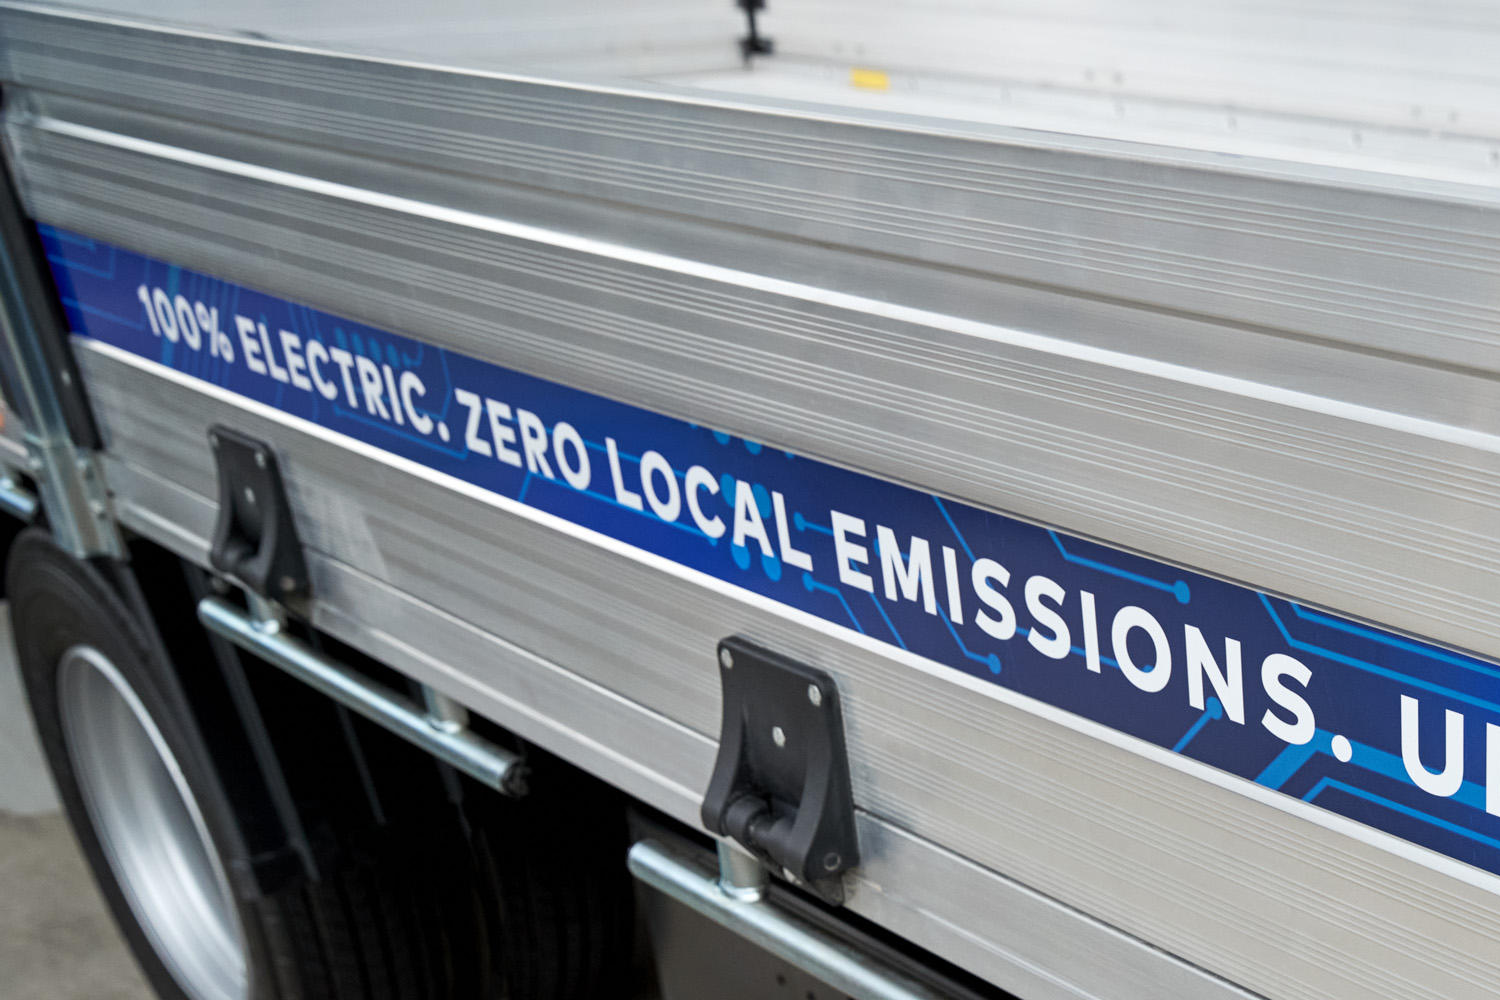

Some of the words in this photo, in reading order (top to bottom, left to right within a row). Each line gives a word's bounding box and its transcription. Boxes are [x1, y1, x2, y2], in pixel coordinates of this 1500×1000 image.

[138, 285, 234, 364] 100%
[235, 315, 451, 443] ELECTRIC.
[455, 387, 592, 491] ZERO
[605, 436, 814, 573] LOCAL
[829, 509, 1353, 763] EMISSIONS.
